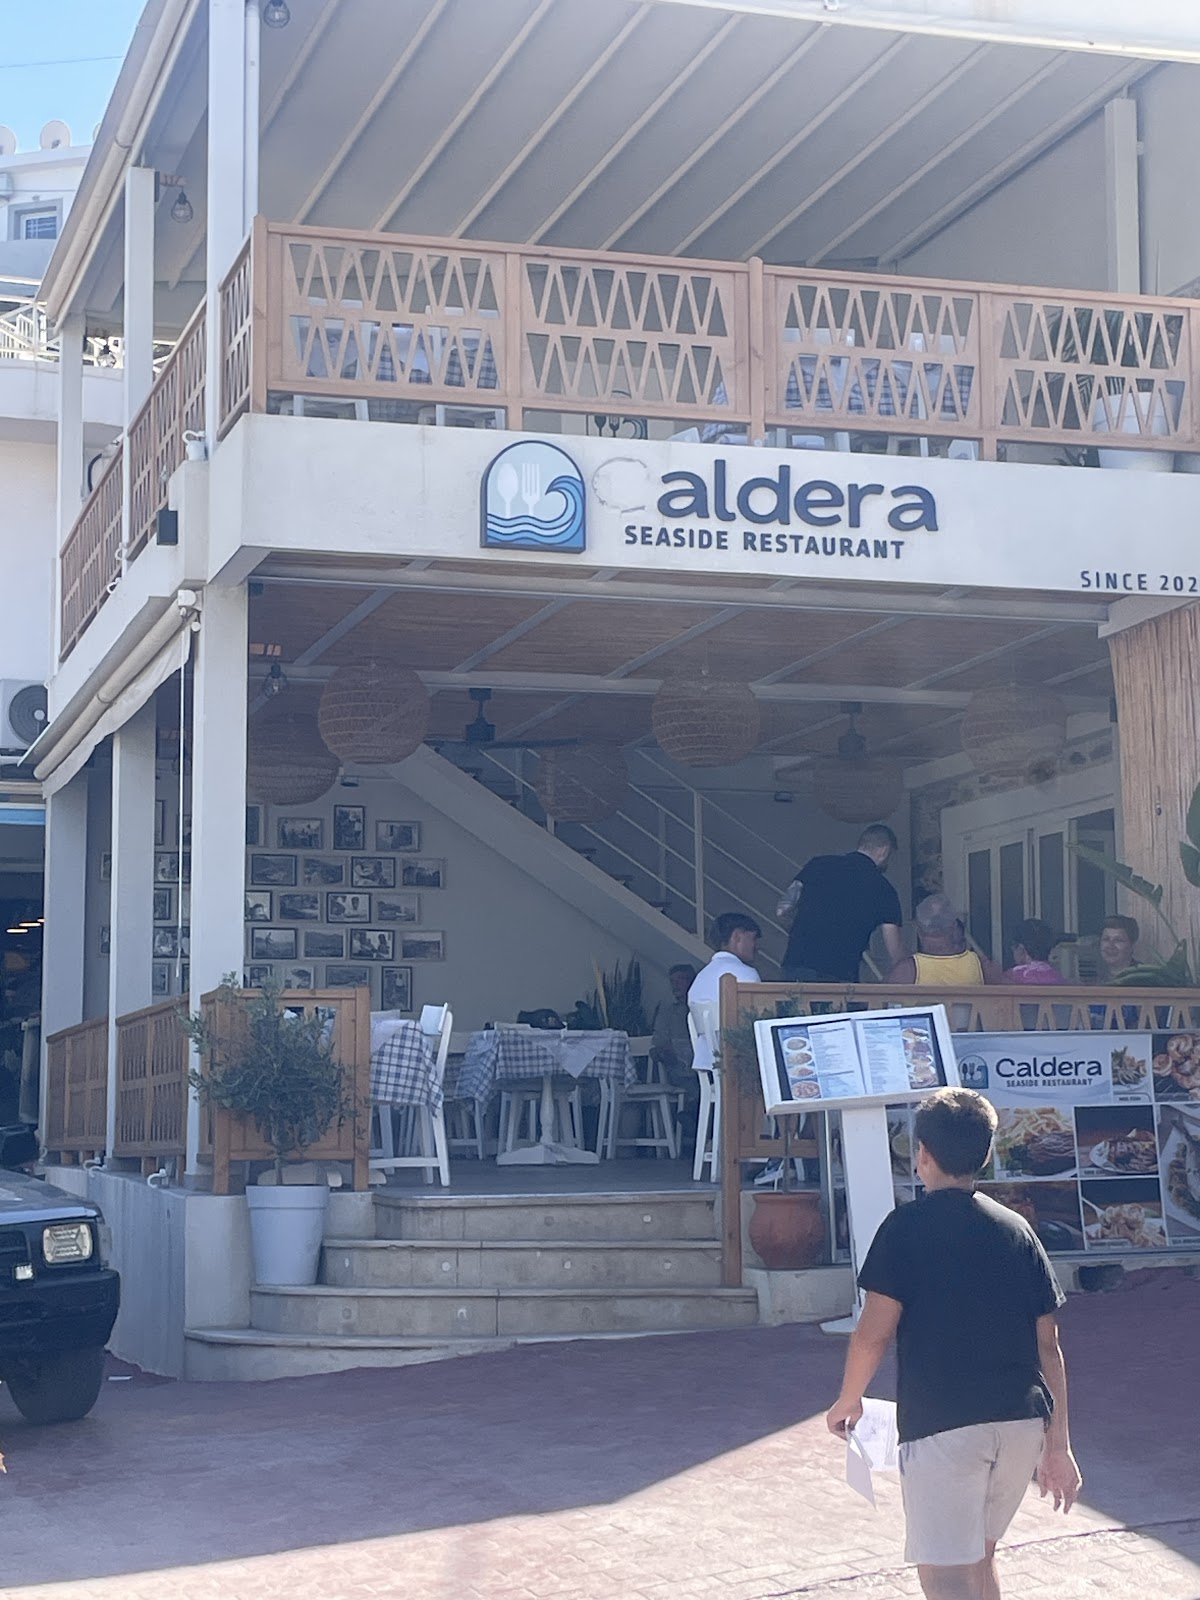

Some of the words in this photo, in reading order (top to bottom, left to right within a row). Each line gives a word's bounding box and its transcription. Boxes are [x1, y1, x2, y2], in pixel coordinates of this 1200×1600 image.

[592, 457, 939, 532] aldera
[624, 525, 729, 550] SEASIDE
[743, 532, 905, 560] RESTAURANT
[1080, 570, 1148, 591] SINCE
[995, 1056, 1103, 1078] Caldera
[1006, 1079, 1039, 1087] SEASIDE
[1042, 1078, 1093, 1087] RESTAURANT
